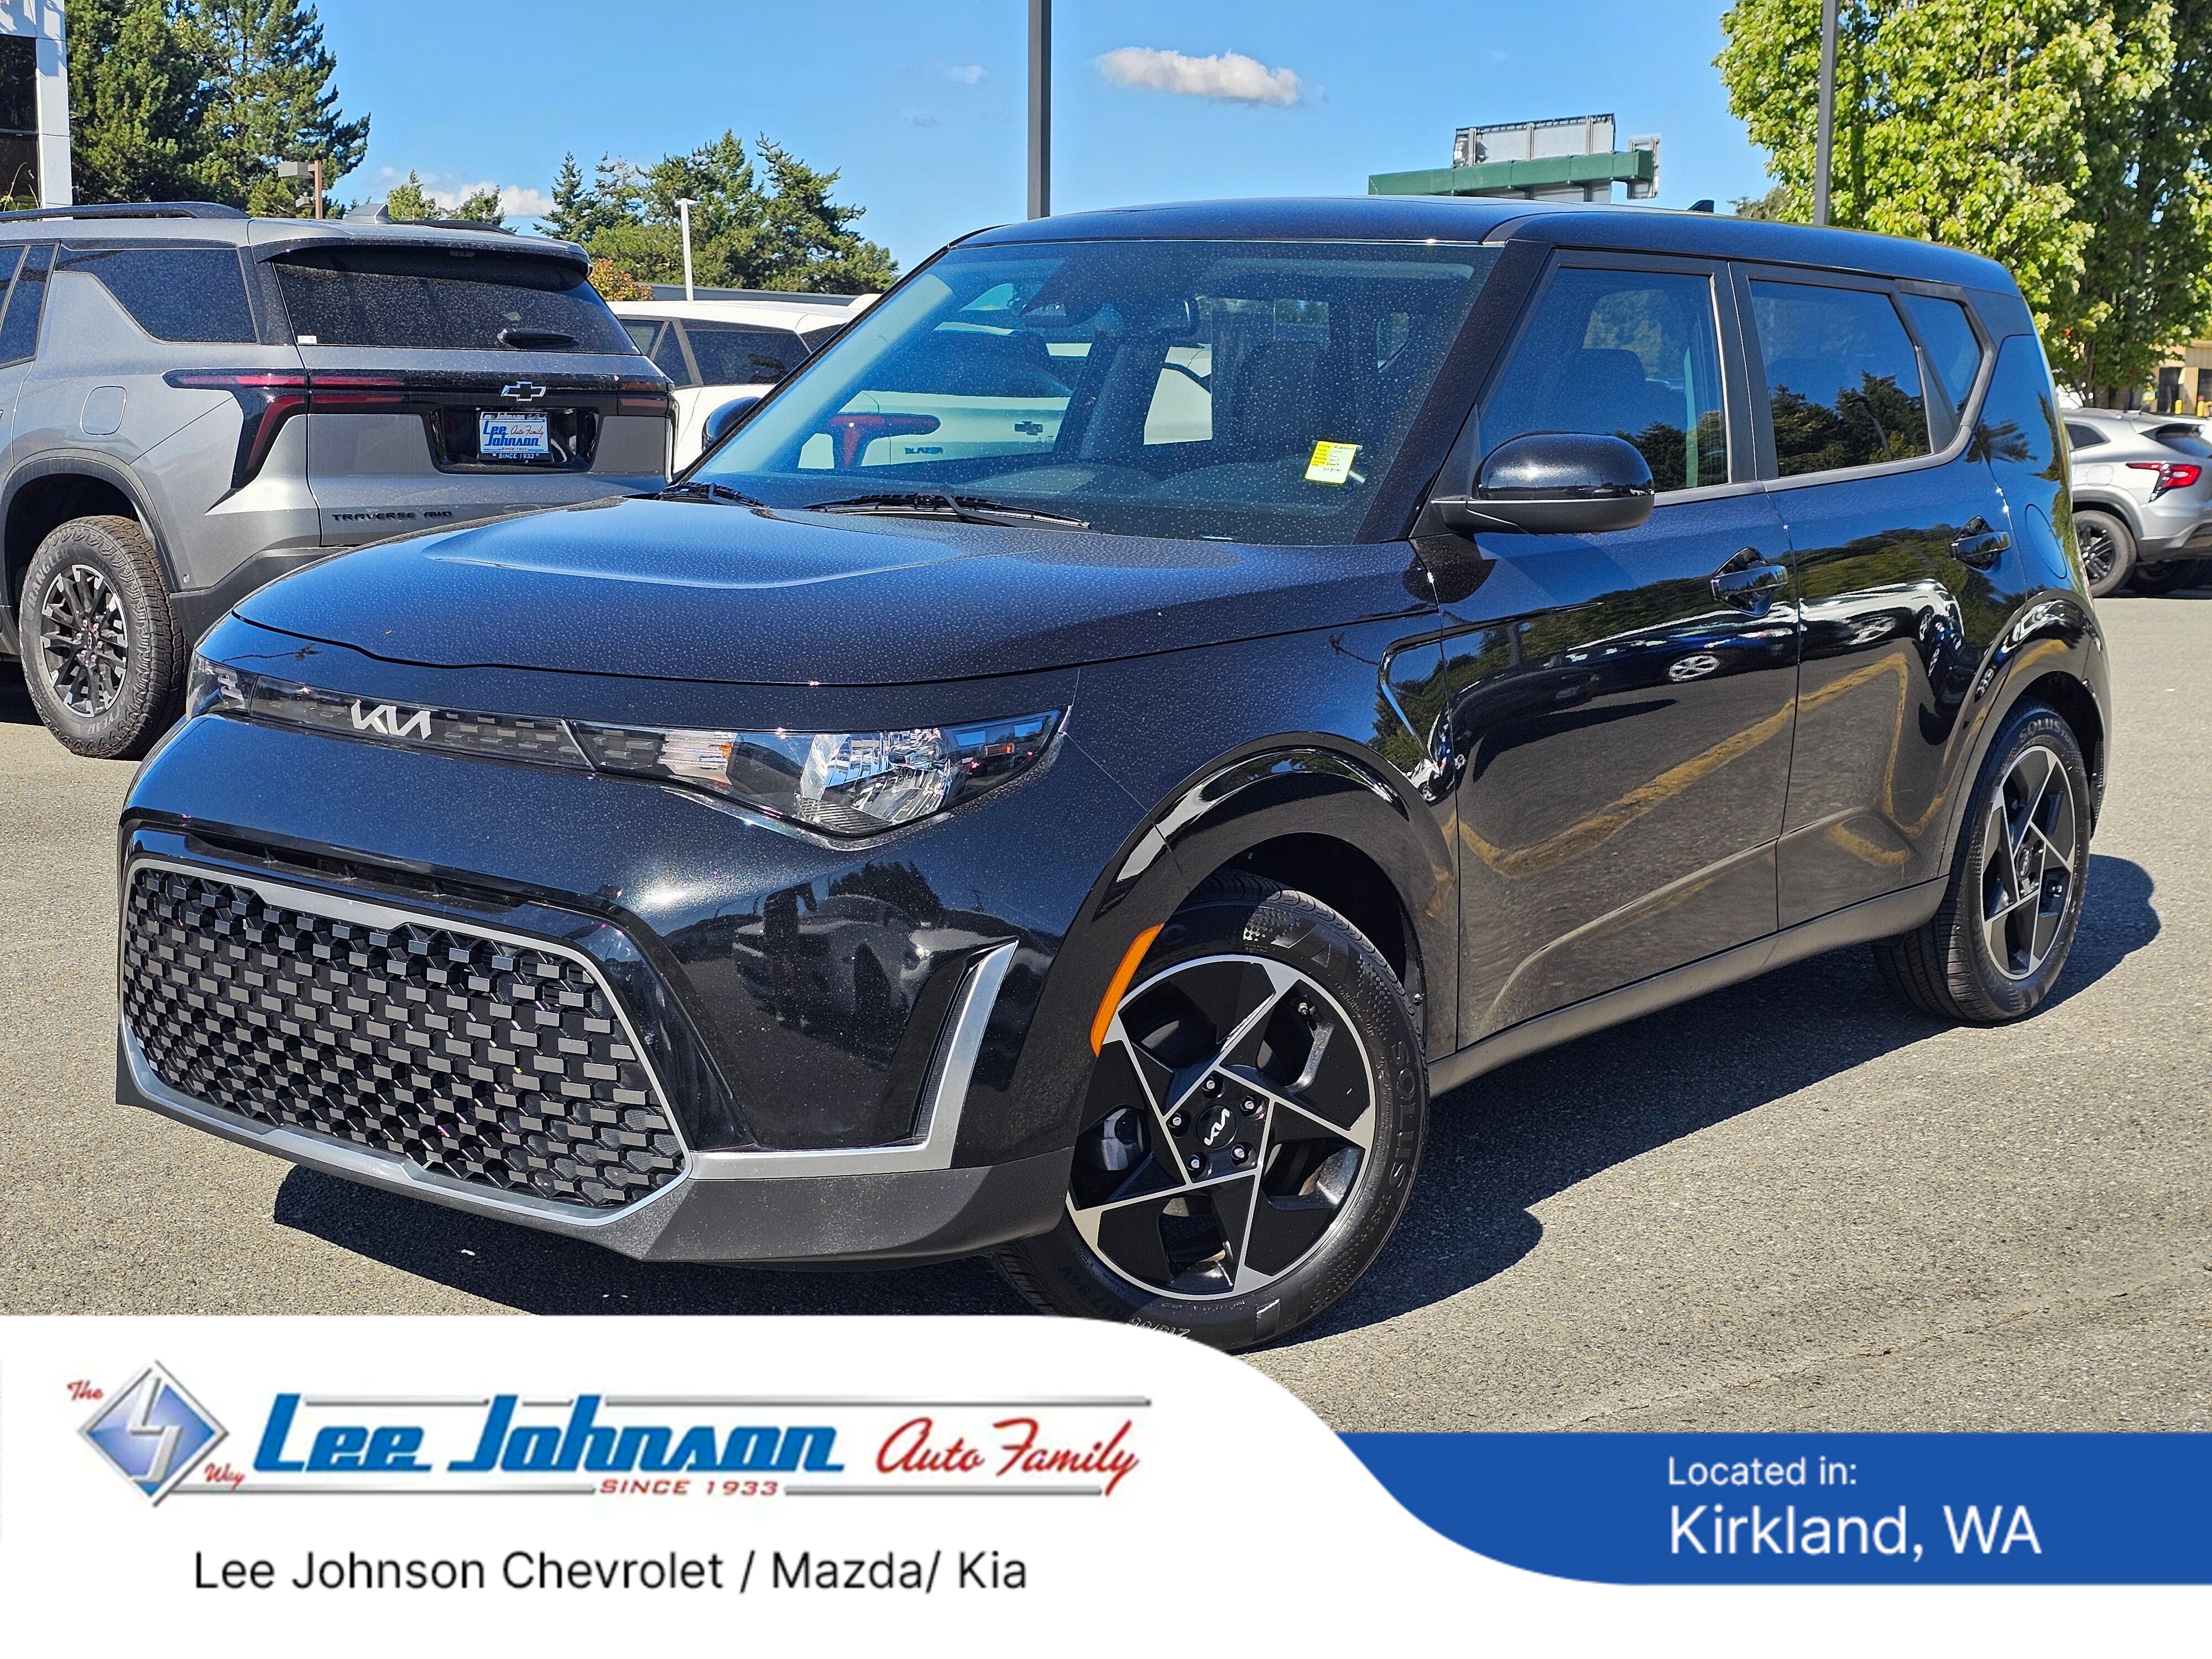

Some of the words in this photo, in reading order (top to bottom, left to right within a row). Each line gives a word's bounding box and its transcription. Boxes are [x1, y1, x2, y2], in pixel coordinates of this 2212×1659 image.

[483, 420, 508, 435] Lee
[511, 425, 524, 435] Auto
[525, 425, 544, 439] Family
[484, 432, 540, 446] Johnson
[332, 512, 416, 521] TRAVERSE
[27, 547, 69, 622] WRANGLER
[2019, 718, 2062, 744] SOLUS
[1389, 1040, 1416, 1188] SOLUS
